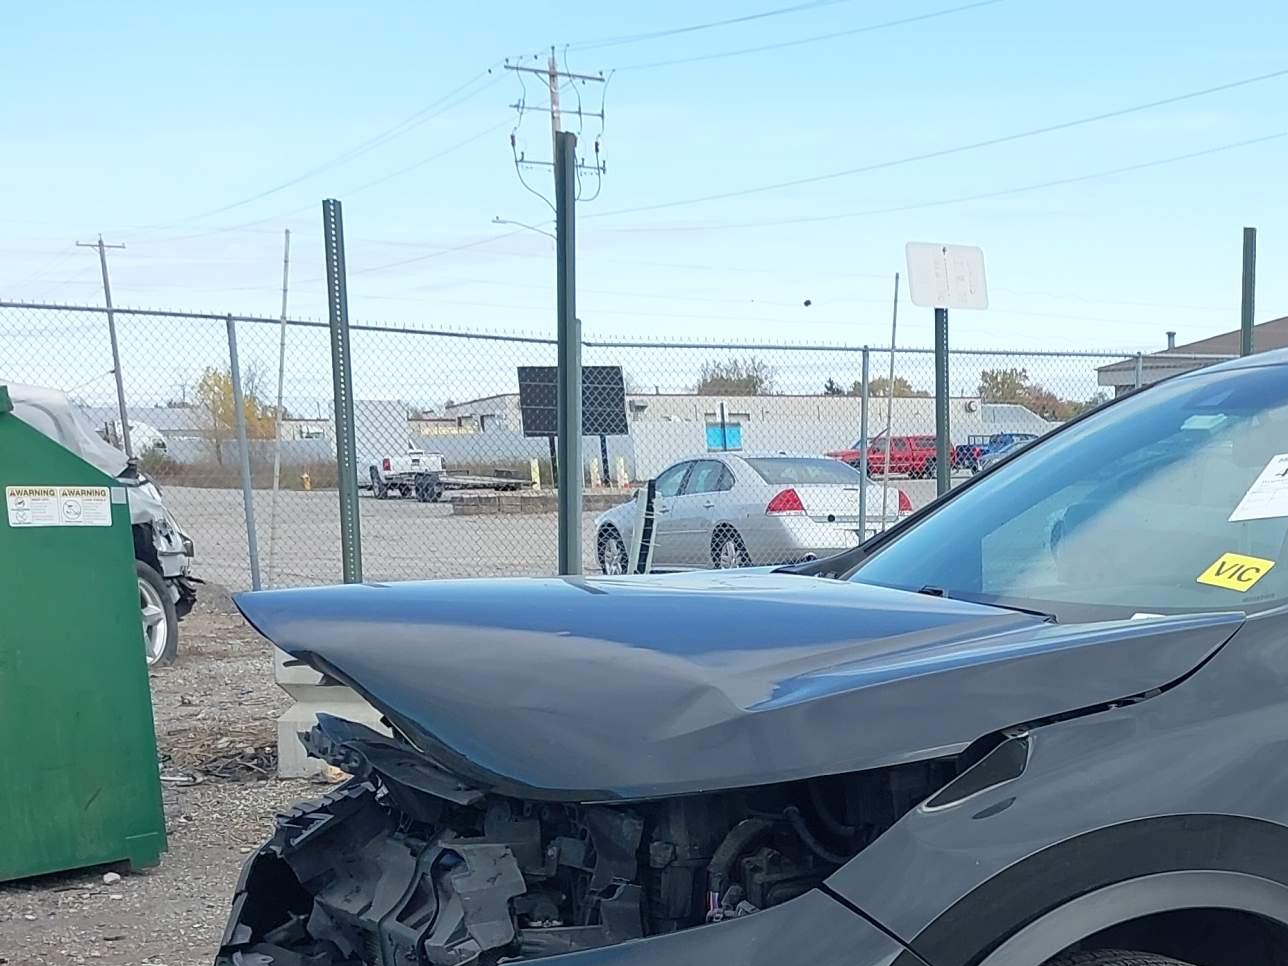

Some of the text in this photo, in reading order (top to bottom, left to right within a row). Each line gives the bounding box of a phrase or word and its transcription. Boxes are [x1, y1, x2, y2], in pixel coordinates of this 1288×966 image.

[16, 489, 55, 497] WARNING
[68, 489, 107, 497] WARNING
[1214, 561, 1261, 582] VIC
